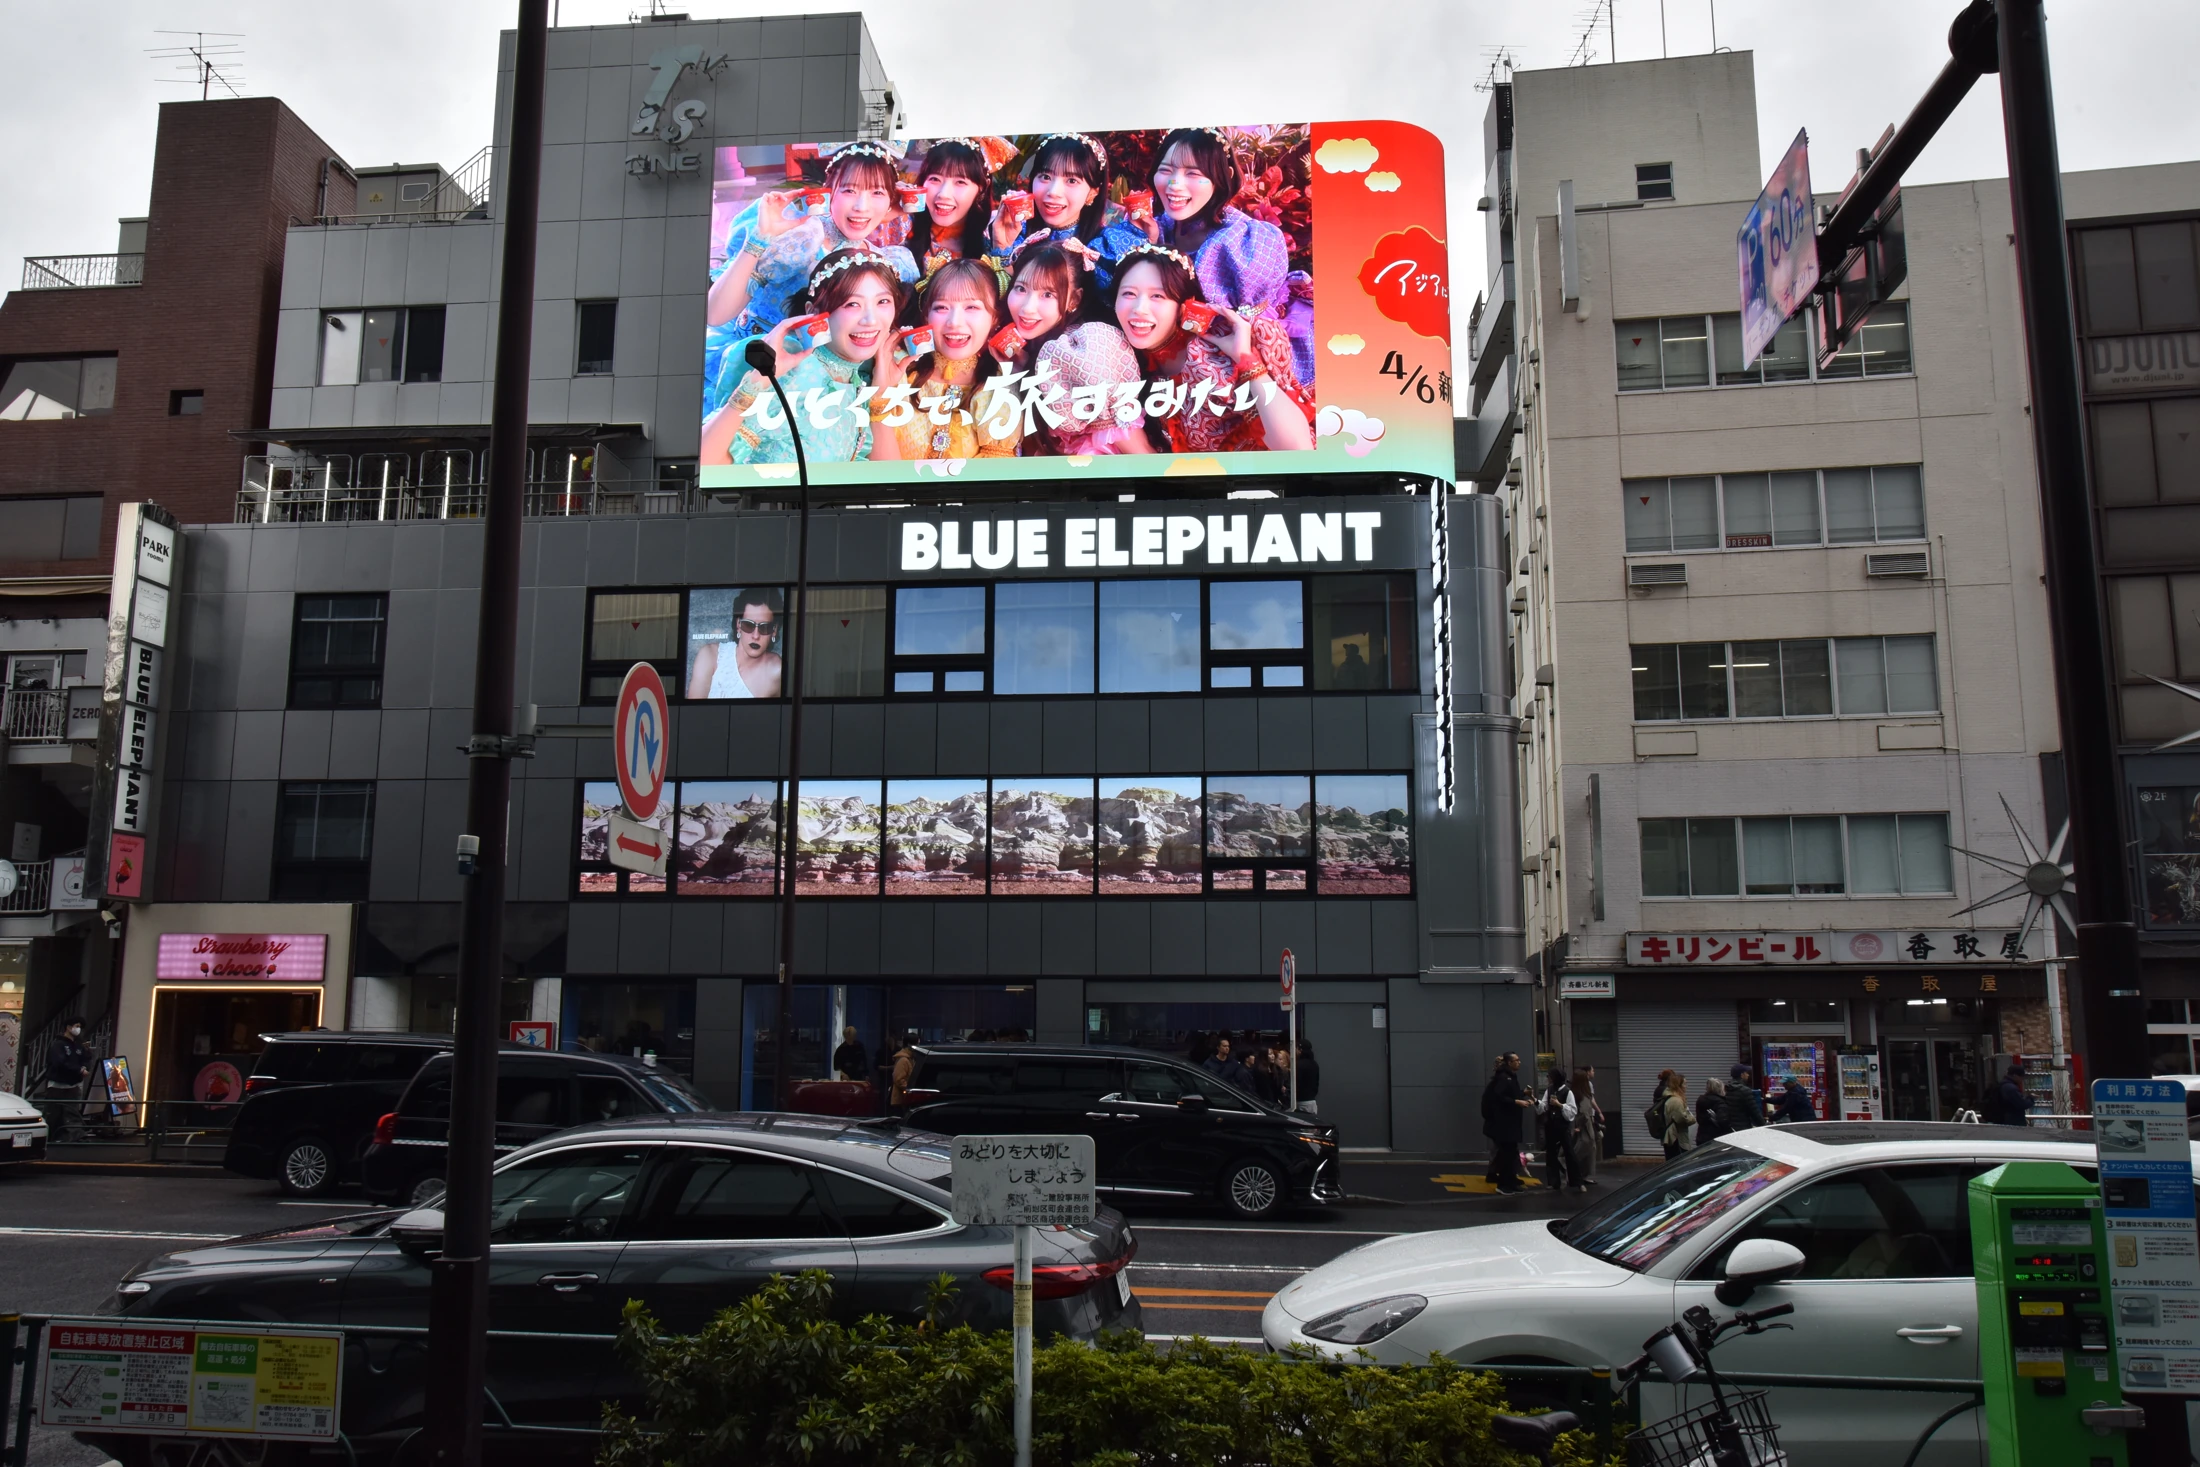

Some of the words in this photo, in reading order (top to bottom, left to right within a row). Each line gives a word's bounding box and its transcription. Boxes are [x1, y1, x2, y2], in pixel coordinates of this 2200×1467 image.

[142, 536, 170, 558] PARK
[900, 519, 1048, 571] BLUE
[1065, 512, 1381, 567] ELEPHANT
[1727, 537, 1768, 547] DRESSKIN
[147, 552, 164, 563] rooms
[136, 648, 153, 705] BLUE
[123, 709, 147, 829] ELEPHANT
[2154, 791, 2167, 802] 2F
[193, 937, 291, 960] Strawberry
[1640, 936, 1821, 963] キリンビール
[1905, 932, 2029, 961] 香取屋
[213, 959, 266, 976] choco
[1861, 974, 1998, 992] 香取屋
[2106, 1084, 2171, 1097] 利用方法
[960, 1144, 1071, 1160] みどりを大切に
[2101, 1162, 2108, 1171] 2
[2106, 1220, 2113, 1229] 3
[2111, 1278, 2118, 1287] 4
[60, 1331, 185, 1350] 自転車等放置禁止区域
[2116, 1337, 2123, 1346] 5
